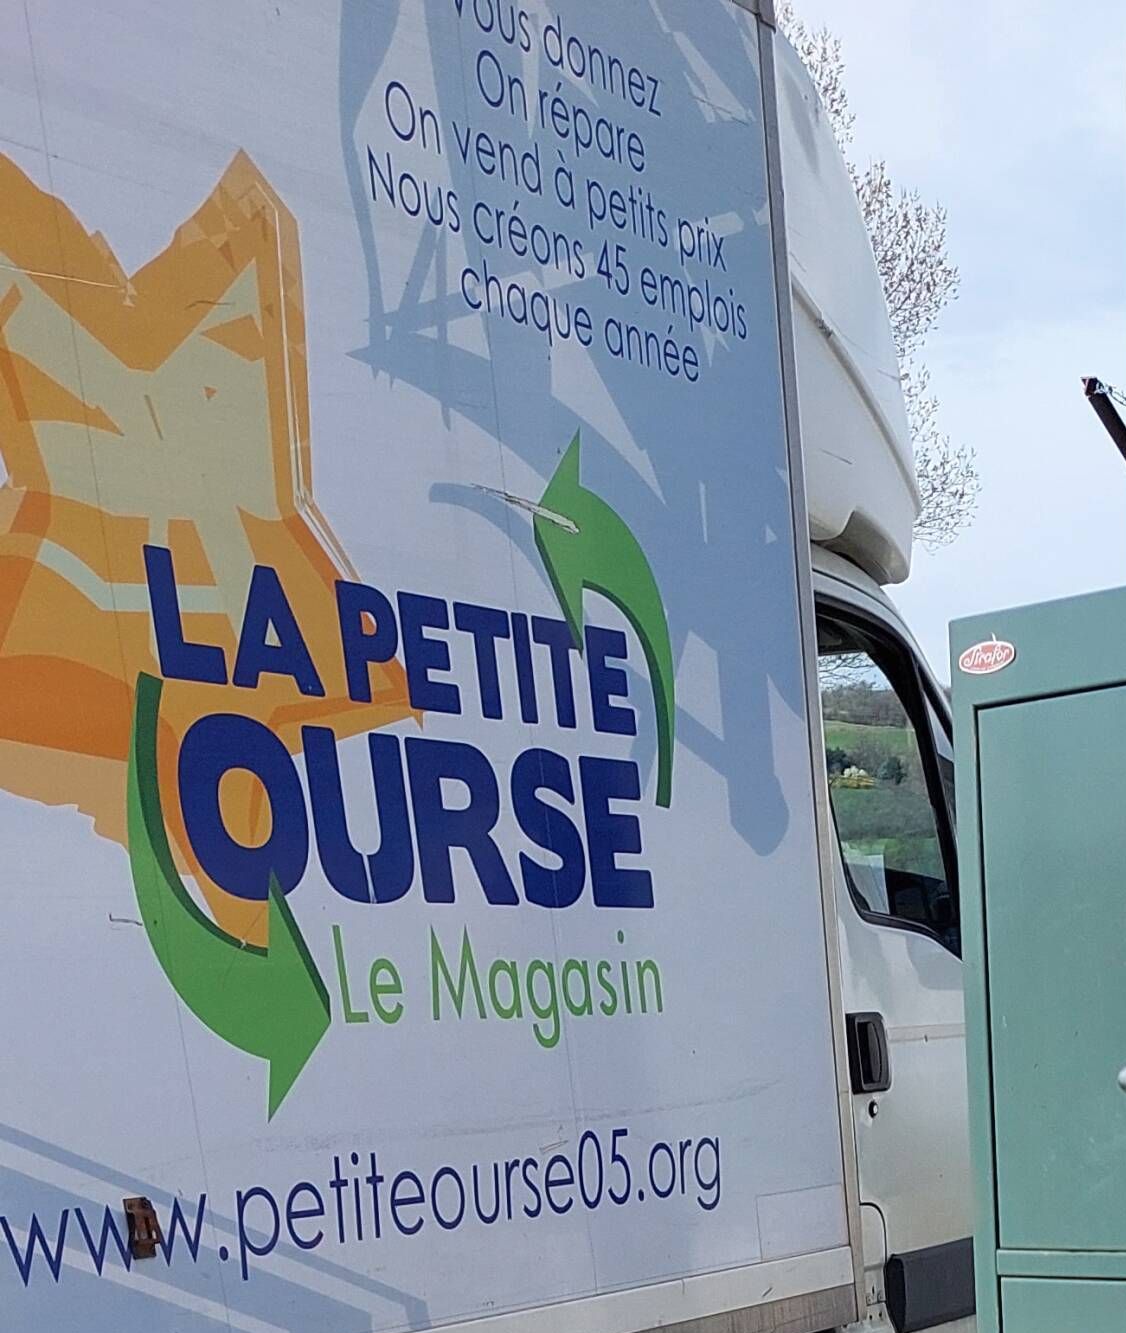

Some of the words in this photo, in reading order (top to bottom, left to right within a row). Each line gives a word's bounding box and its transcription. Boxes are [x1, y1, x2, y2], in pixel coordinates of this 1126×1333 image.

[476, 49, 528, 121] On
[538, 81, 646, 173] répare
[543, 15, 662, 117] donnez
[367, 145, 461, 233] Nous
[473, 201, 586, 279] créons
[597, 240, 630, 296] 45
[640, 267, 748, 341] emplois
[385, 81, 441, 155] On
[451, 121, 543, 196] vend
[553, 150, 576, 210] à
[586, 178, 669, 248] petits
[678, 217, 727, 273] prix
[461, 258, 593, 348] chaque
[604, 314, 700, 383] année
[143, 544, 326, 698] LA
[335, 579, 639, 737] PETITE
[177, 713, 656, 910] OURSE
[330, 926, 403, 1025] Le
[430, 925, 664, 1050] Magasin
[0, 1130, 722, 1288] www.petiteourse05.org
